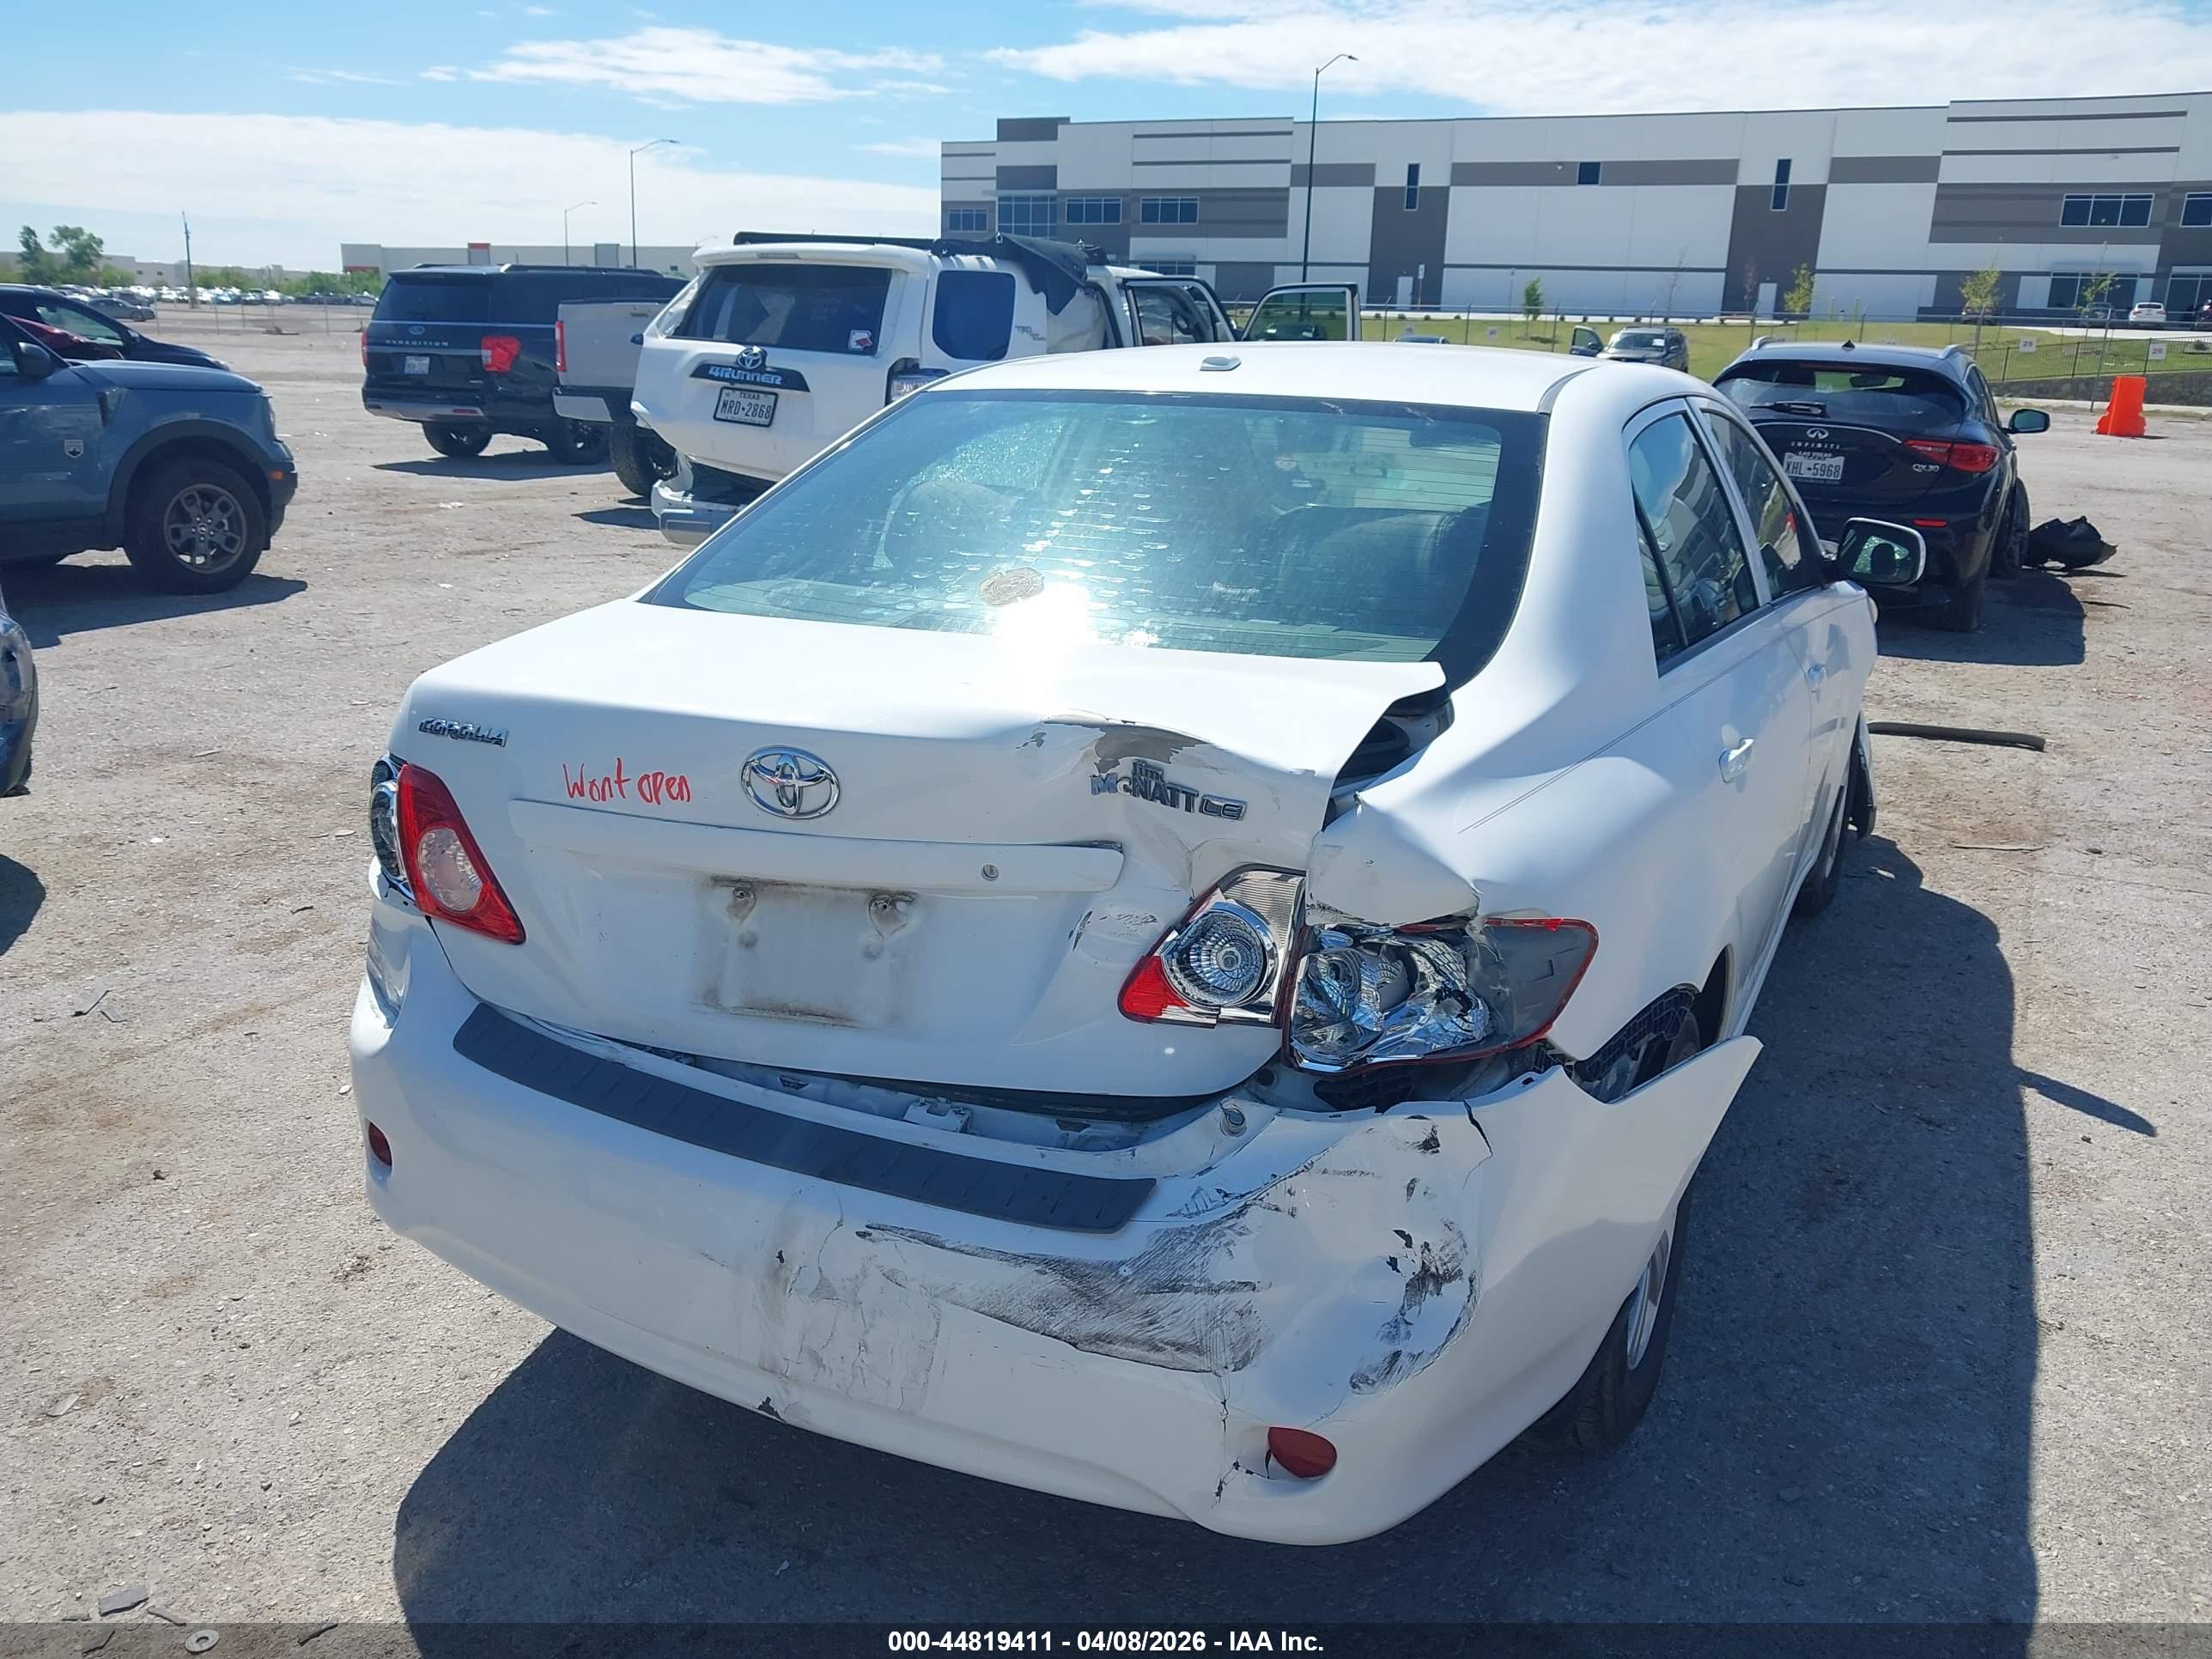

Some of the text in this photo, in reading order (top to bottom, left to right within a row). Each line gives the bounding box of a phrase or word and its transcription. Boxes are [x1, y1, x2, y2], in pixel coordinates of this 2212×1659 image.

[738, 392, 761, 401] TEXAS
[1790, 441, 1841, 450] INFINITI
[418, 715, 509, 748] COROLLA
[562, 757, 632, 802] Wont
[1201, 796, 1245, 821] LE
